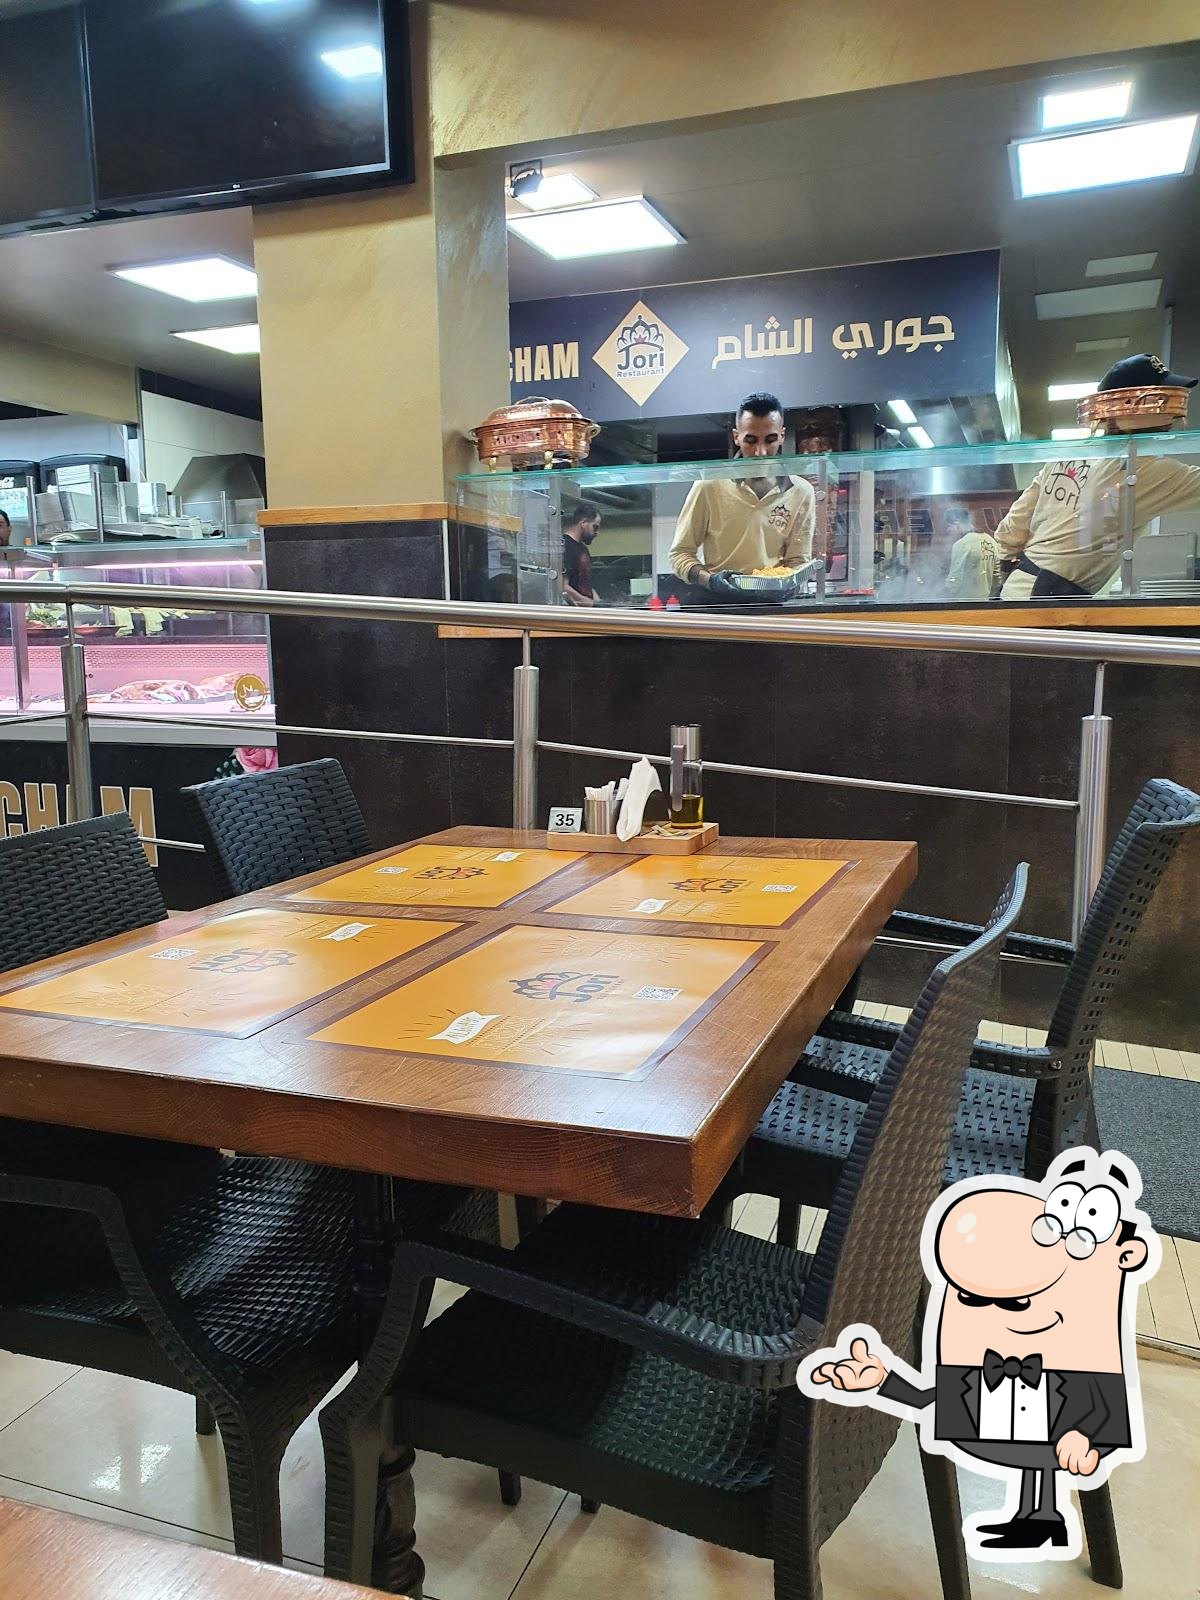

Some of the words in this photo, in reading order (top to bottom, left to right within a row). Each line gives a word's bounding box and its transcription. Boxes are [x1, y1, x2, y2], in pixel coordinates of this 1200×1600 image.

[711, 315, 813, 370] الشام
[832, 313, 955, 359] جوري
[509, 341, 580, 384] HAM
[616, 368, 665, 378] Restaurant
[617, 345, 665, 371] Jori
[1044, 472, 1081, 511] Jori
[0, 780, 159, 868] CHM
[554, 812, 576, 827] 35
